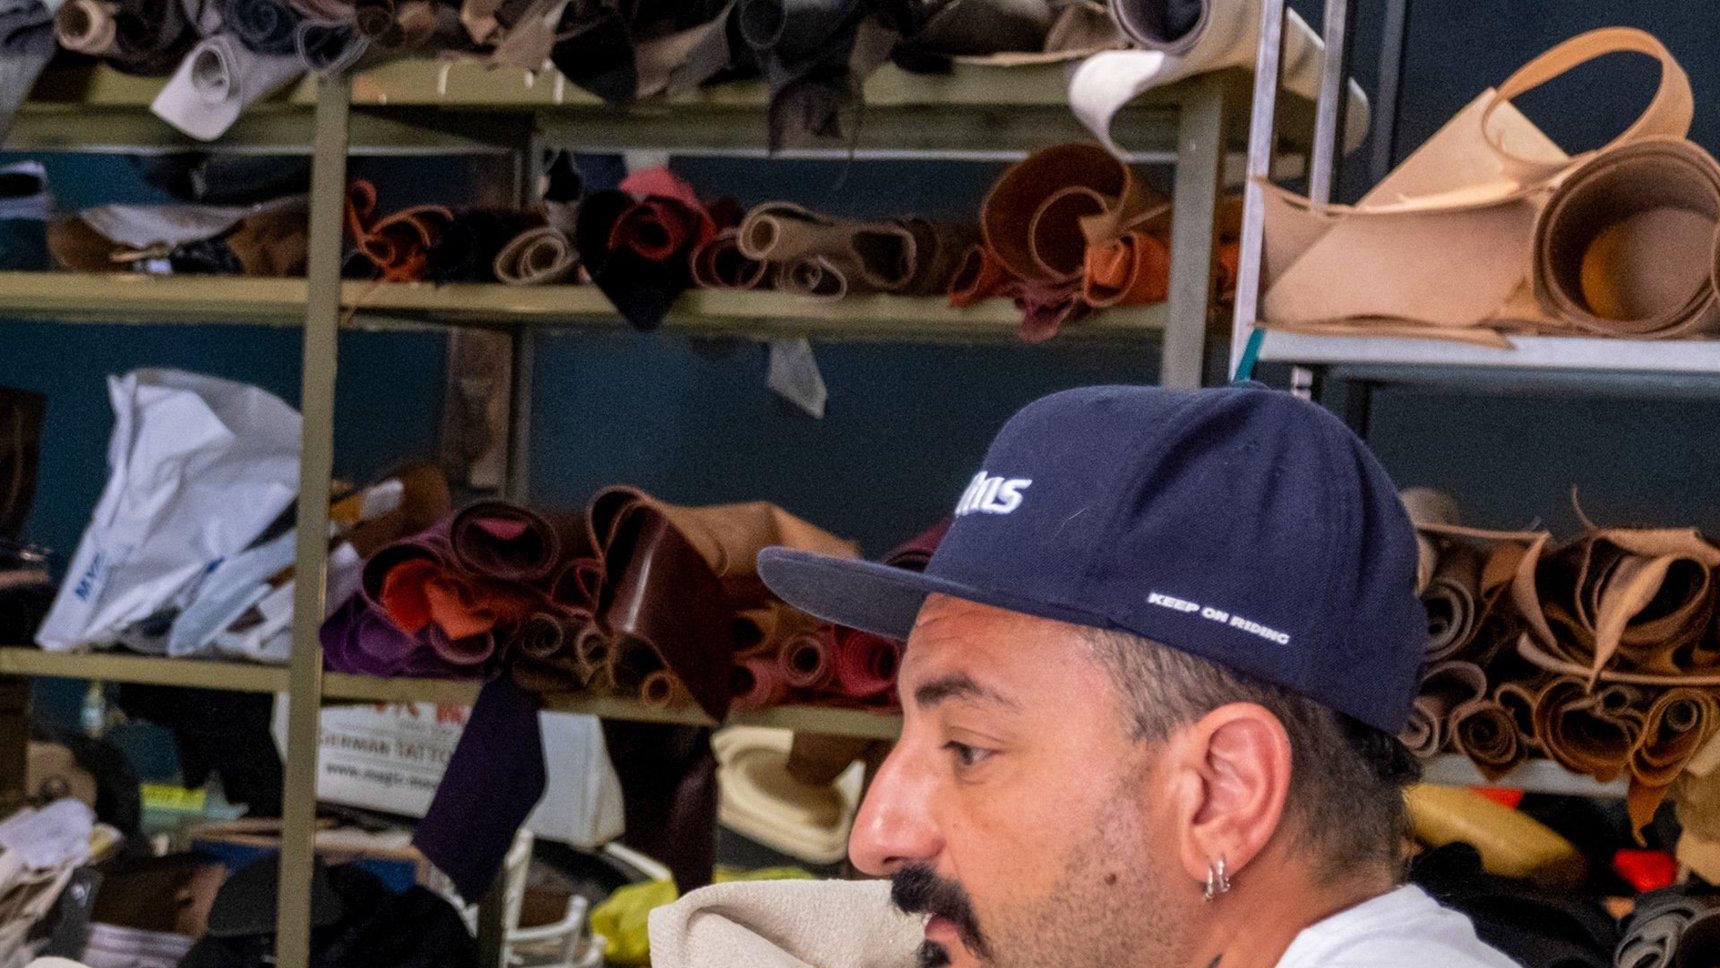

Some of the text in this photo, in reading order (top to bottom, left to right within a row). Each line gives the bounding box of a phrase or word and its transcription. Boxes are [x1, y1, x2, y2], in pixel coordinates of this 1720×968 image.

[1148, 592, 1291, 645] KEEP ON RIDING
